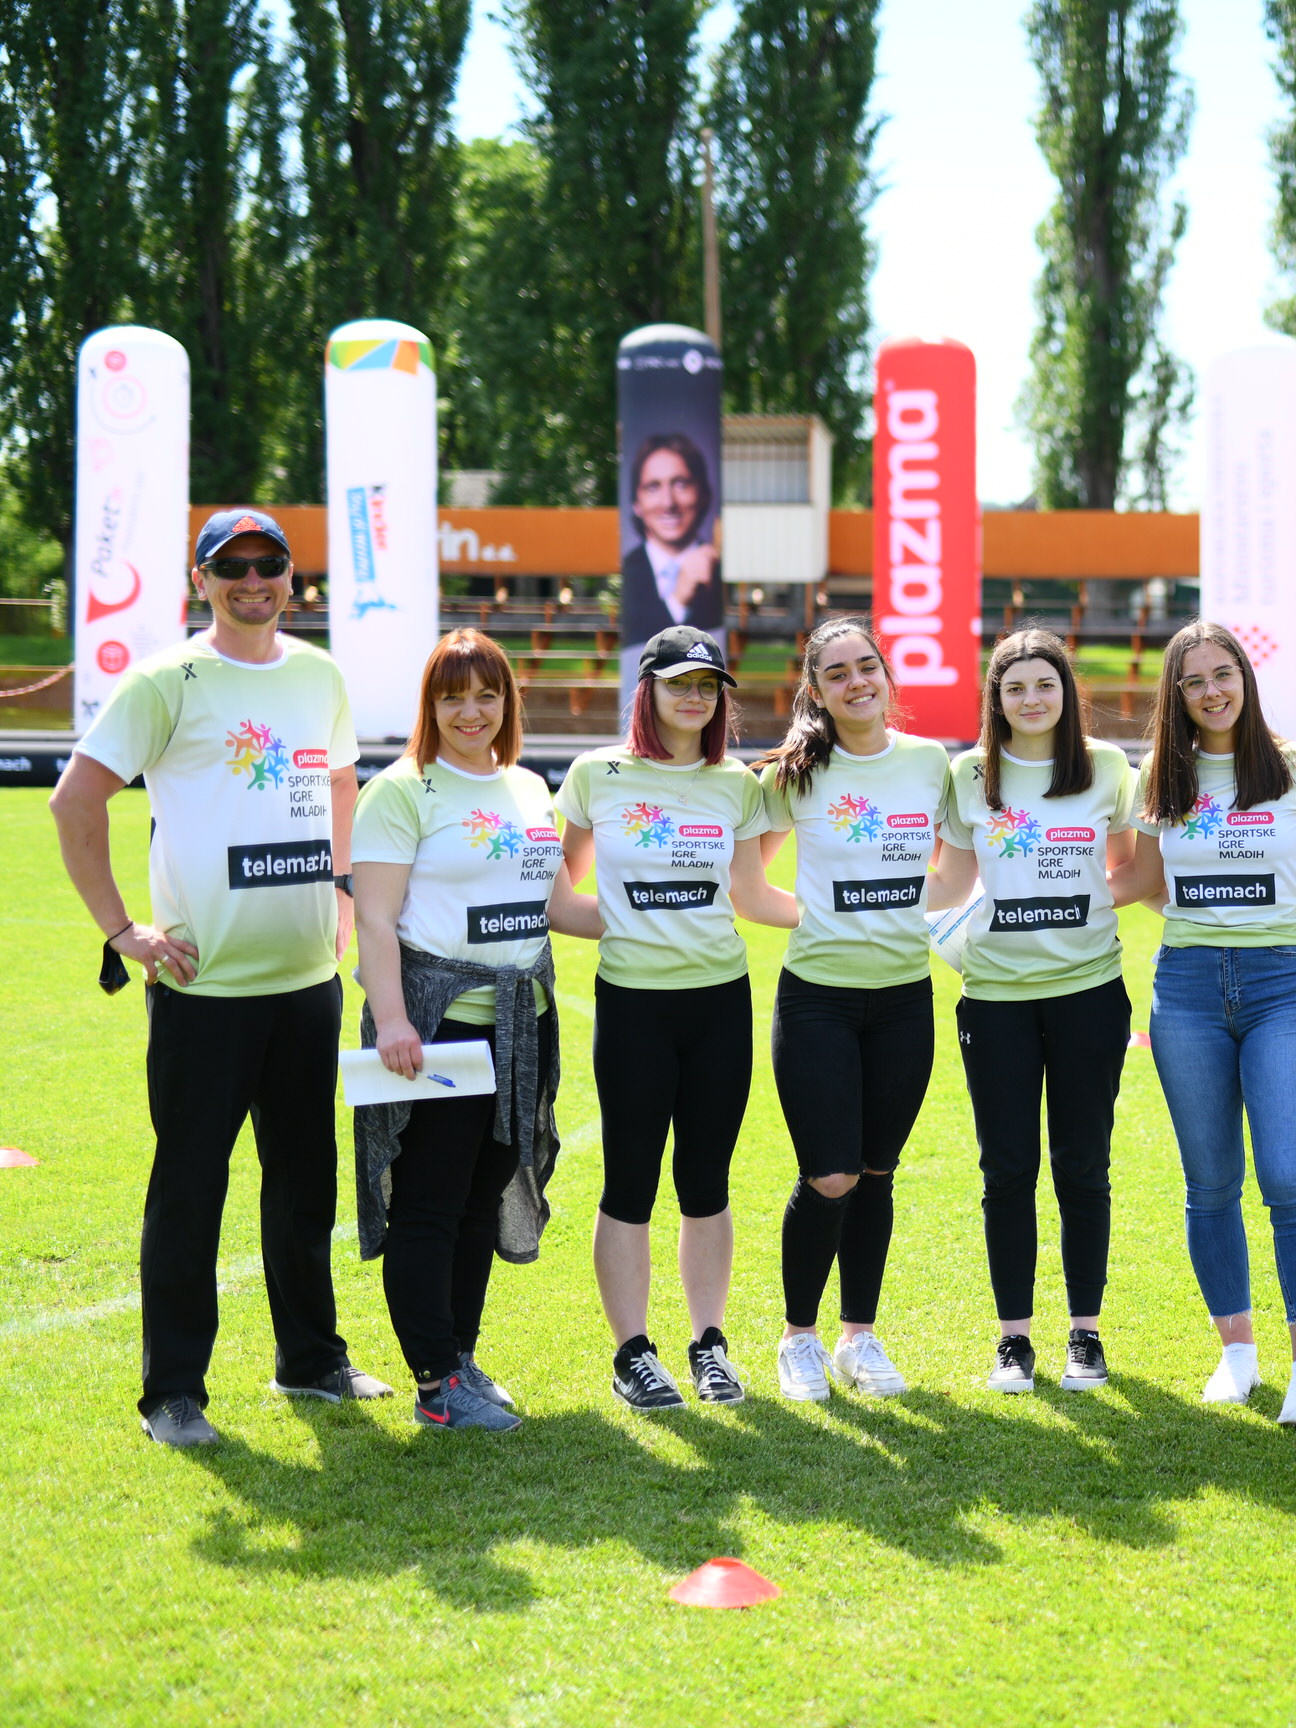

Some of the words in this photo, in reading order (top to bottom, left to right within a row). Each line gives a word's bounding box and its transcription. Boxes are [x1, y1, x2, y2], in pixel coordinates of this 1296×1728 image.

[879, 388, 959, 686] plazma
[686, 651, 713, 662] adidas
[289, 790, 314, 803] IGRE
[890, 816, 925, 827] plazma
[1230, 813, 1269, 824] plazma
[529, 829, 559, 841] plazm
[682, 826, 719, 836] plazma
[881, 831, 932, 842] SPORTSKE
[1050, 829, 1091, 841] plazma
[1218, 828, 1276, 839] SPORTSKE
[671, 840, 726, 850] SPORTSKE
[882, 843, 906, 852] IGRE
[1218, 839, 1245, 849] IGRE
[523, 846, 561, 857] SPORTS
[671, 850, 697, 858] IGRE
[1037, 846, 1095, 857] SPORTSKE
[1219, 850, 1264, 859] MLADIH
[881, 853, 922, 862] MLADIH
[1037, 858, 1063, 868] IGRE
[521, 858, 546, 869] IGRE
[671, 860, 714, 869] MLADIH
[1038, 869, 1081, 879] MLADIH
[632, 887, 707, 904] telemach
[842, 885, 916, 905] telemach
[1182, 882, 1267, 900] telemach
[997, 904, 1081, 924] telemach
